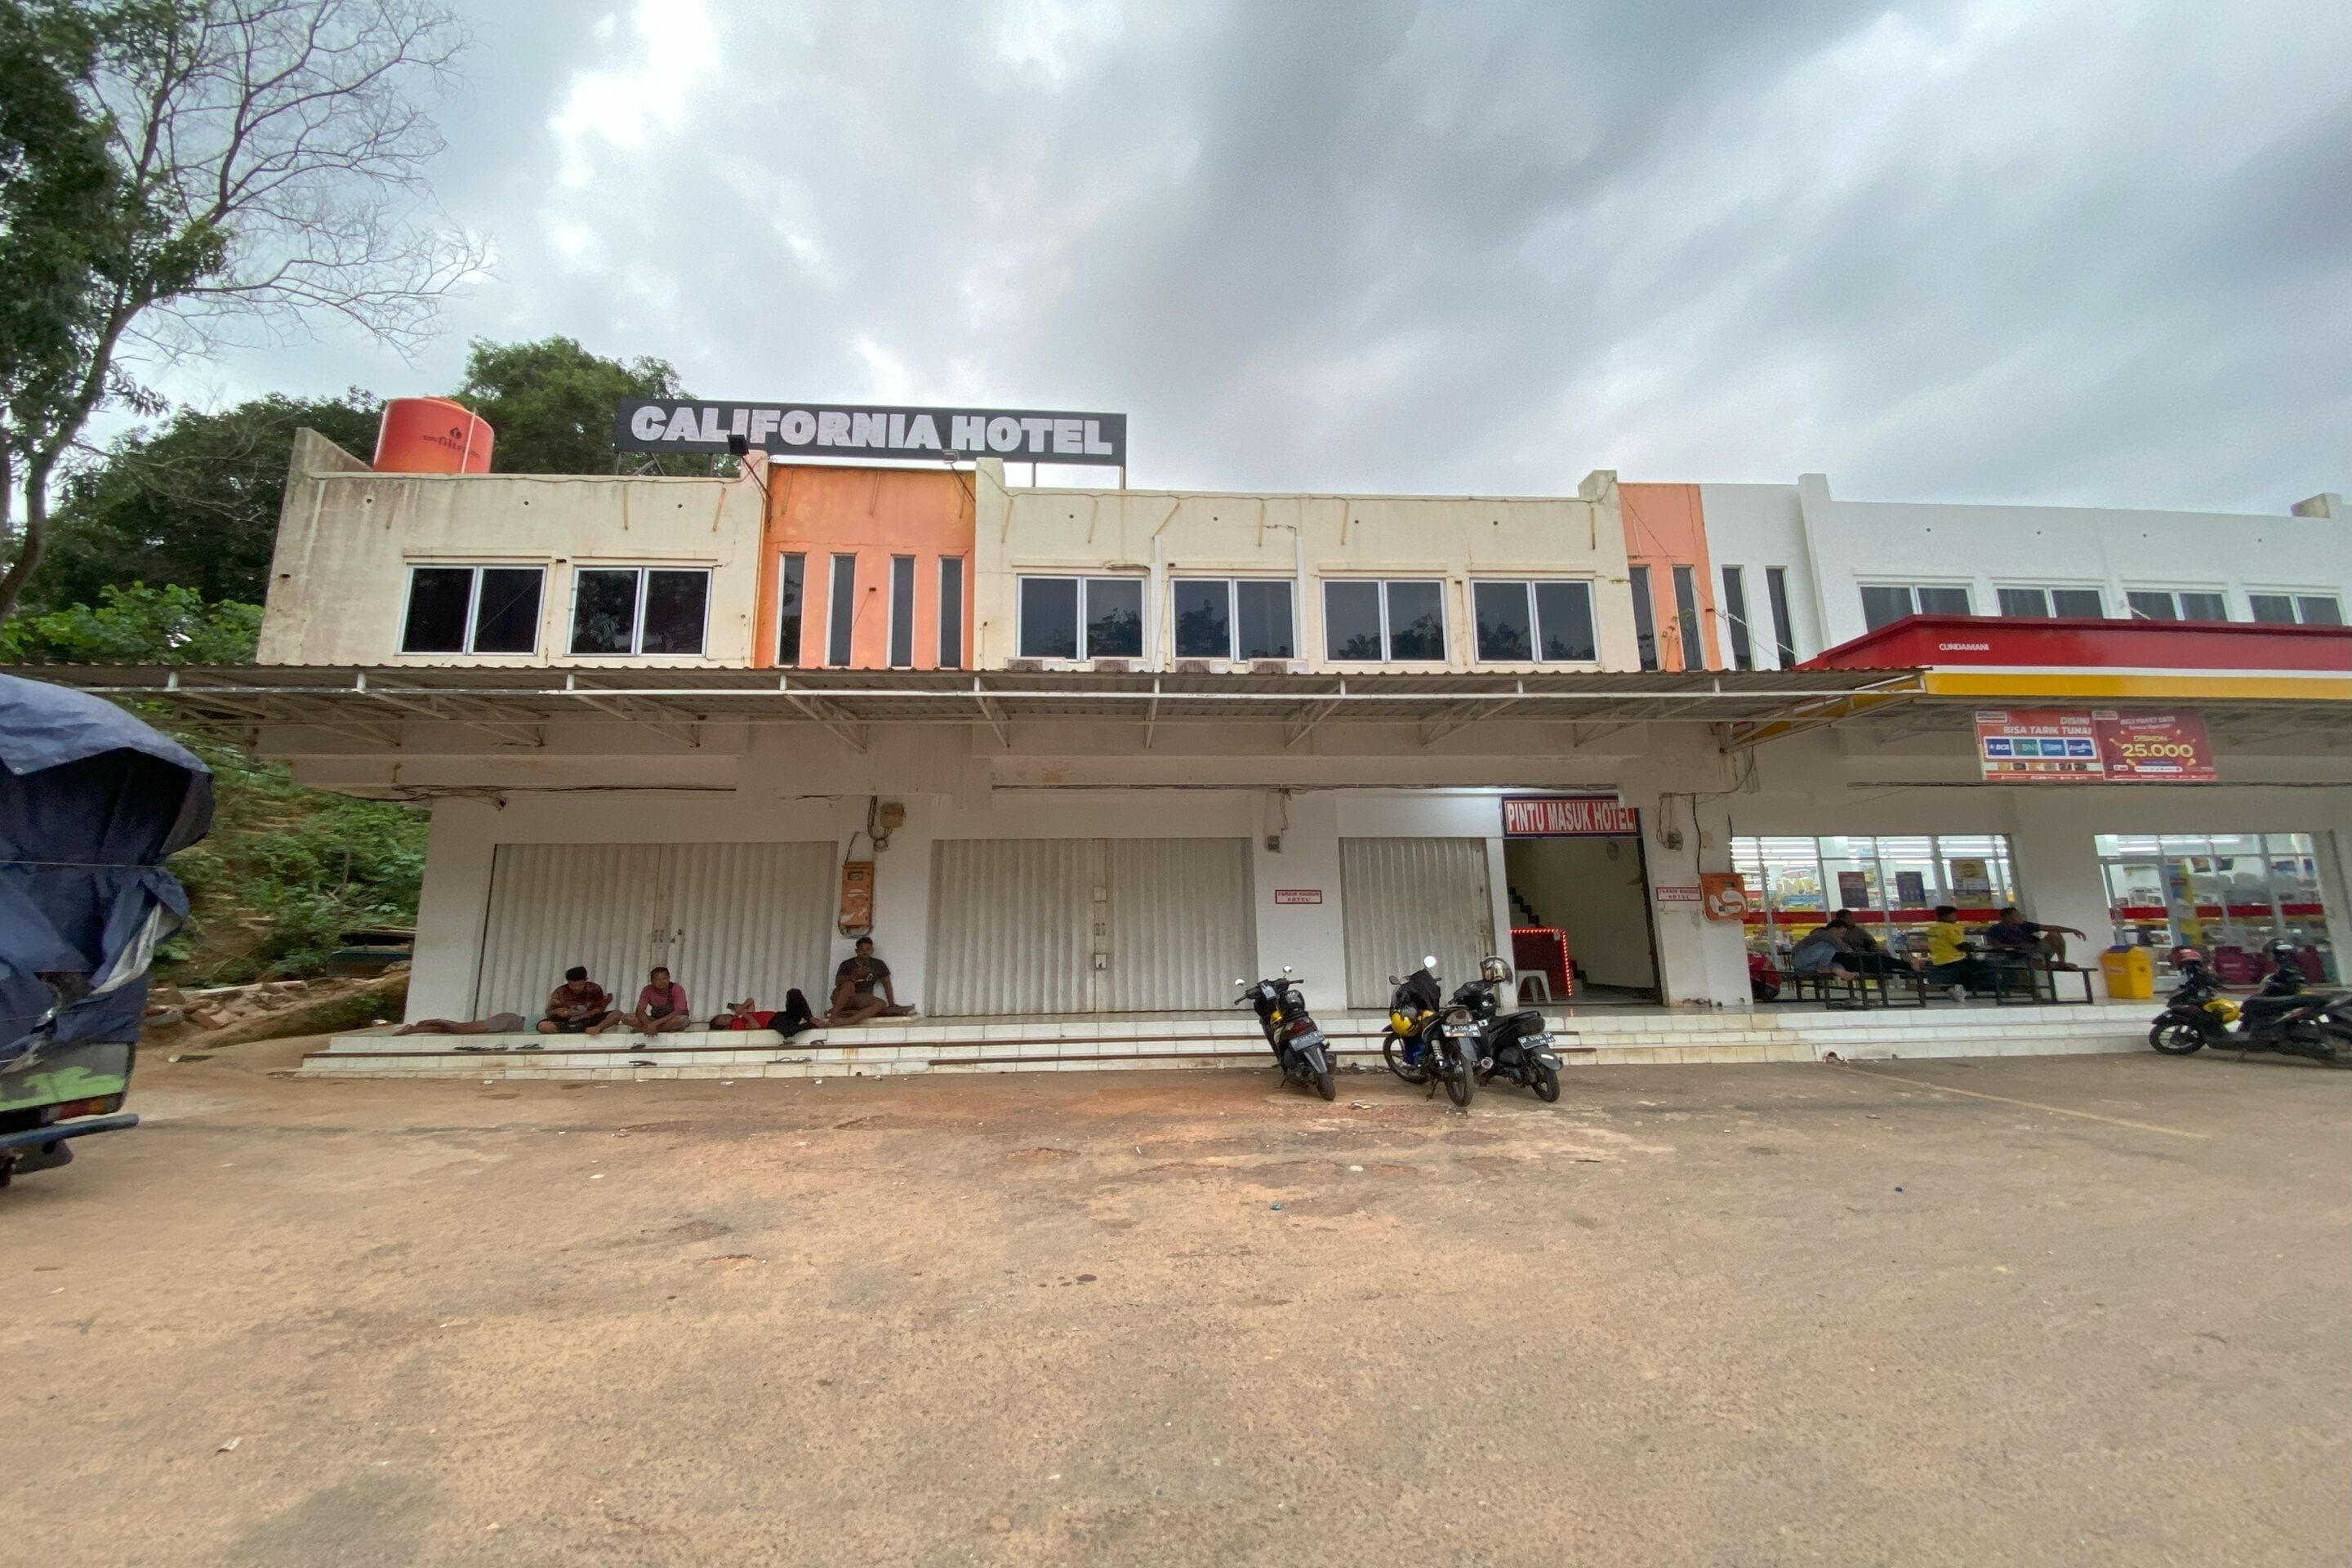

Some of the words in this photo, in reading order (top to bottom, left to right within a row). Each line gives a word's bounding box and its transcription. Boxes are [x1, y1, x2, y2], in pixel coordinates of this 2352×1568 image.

[630, 405, 942, 450] CALIFORNIA
[952, 416, 1113, 455] HOTEL
[2060, 716, 2090, 725] DISINI
[2003, 726, 2028, 734] BISA
[2029, 726, 2059, 734] TARIK
[2061, 726, 2091, 735] TUNAI
[2121, 743, 2194, 758] 25.000
[1507, 803, 1545, 831] PINTU
[1547, 802, 1592, 831] MASUK
[1593, 802, 1634, 831] HOTEL
